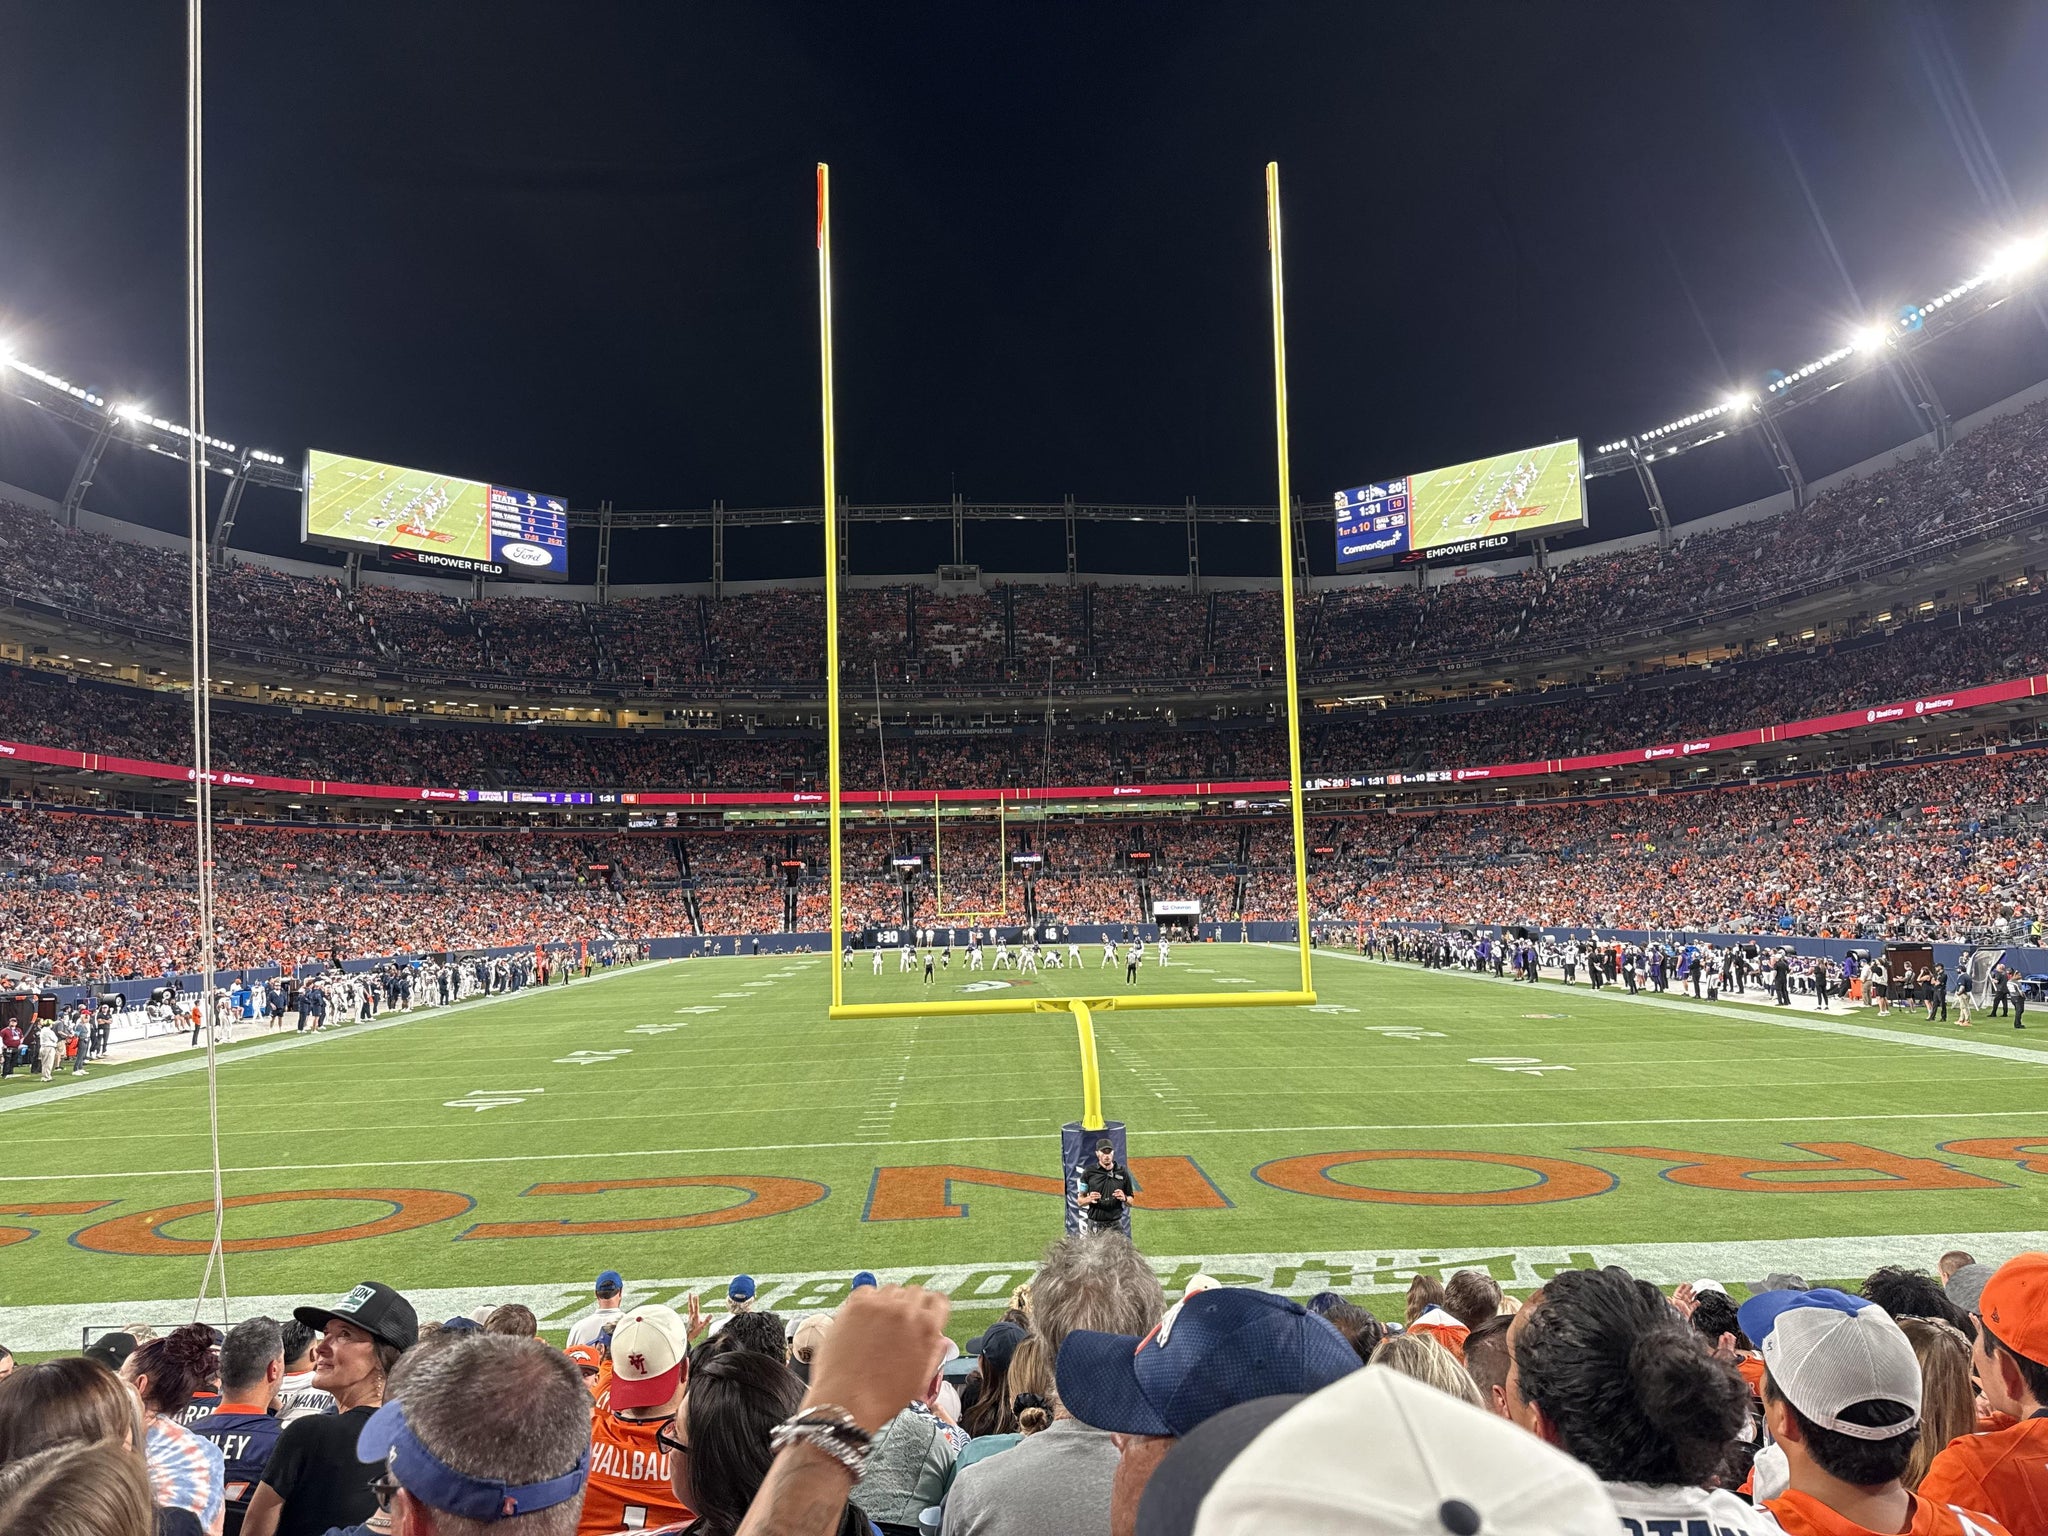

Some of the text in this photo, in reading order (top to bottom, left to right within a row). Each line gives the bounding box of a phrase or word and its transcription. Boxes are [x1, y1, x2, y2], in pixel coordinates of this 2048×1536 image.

[1388, 482, 1402, 494] 20
[1359, 503, 1381, 516] 1:31
[1358, 521, 1371, 532] 10
[1391, 515, 1404, 526] 32
[1426, 536, 1508, 559] EMPOWER FIELD
[418, 554, 503, 575] EMPOWER FIELD
[930, 728, 950, 736] LIGHT
[1332, 778, 1344, 787] 20
[1368, 777, 1384, 785] 1:31
[1416, 774, 1425, 782] 10
[1439, 772, 1452, 781] 32
[599, 795, 615, 803] 1:31
[1466, 1056, 1577, 1072] 10
[441, 1087, 545, 1107] 10
